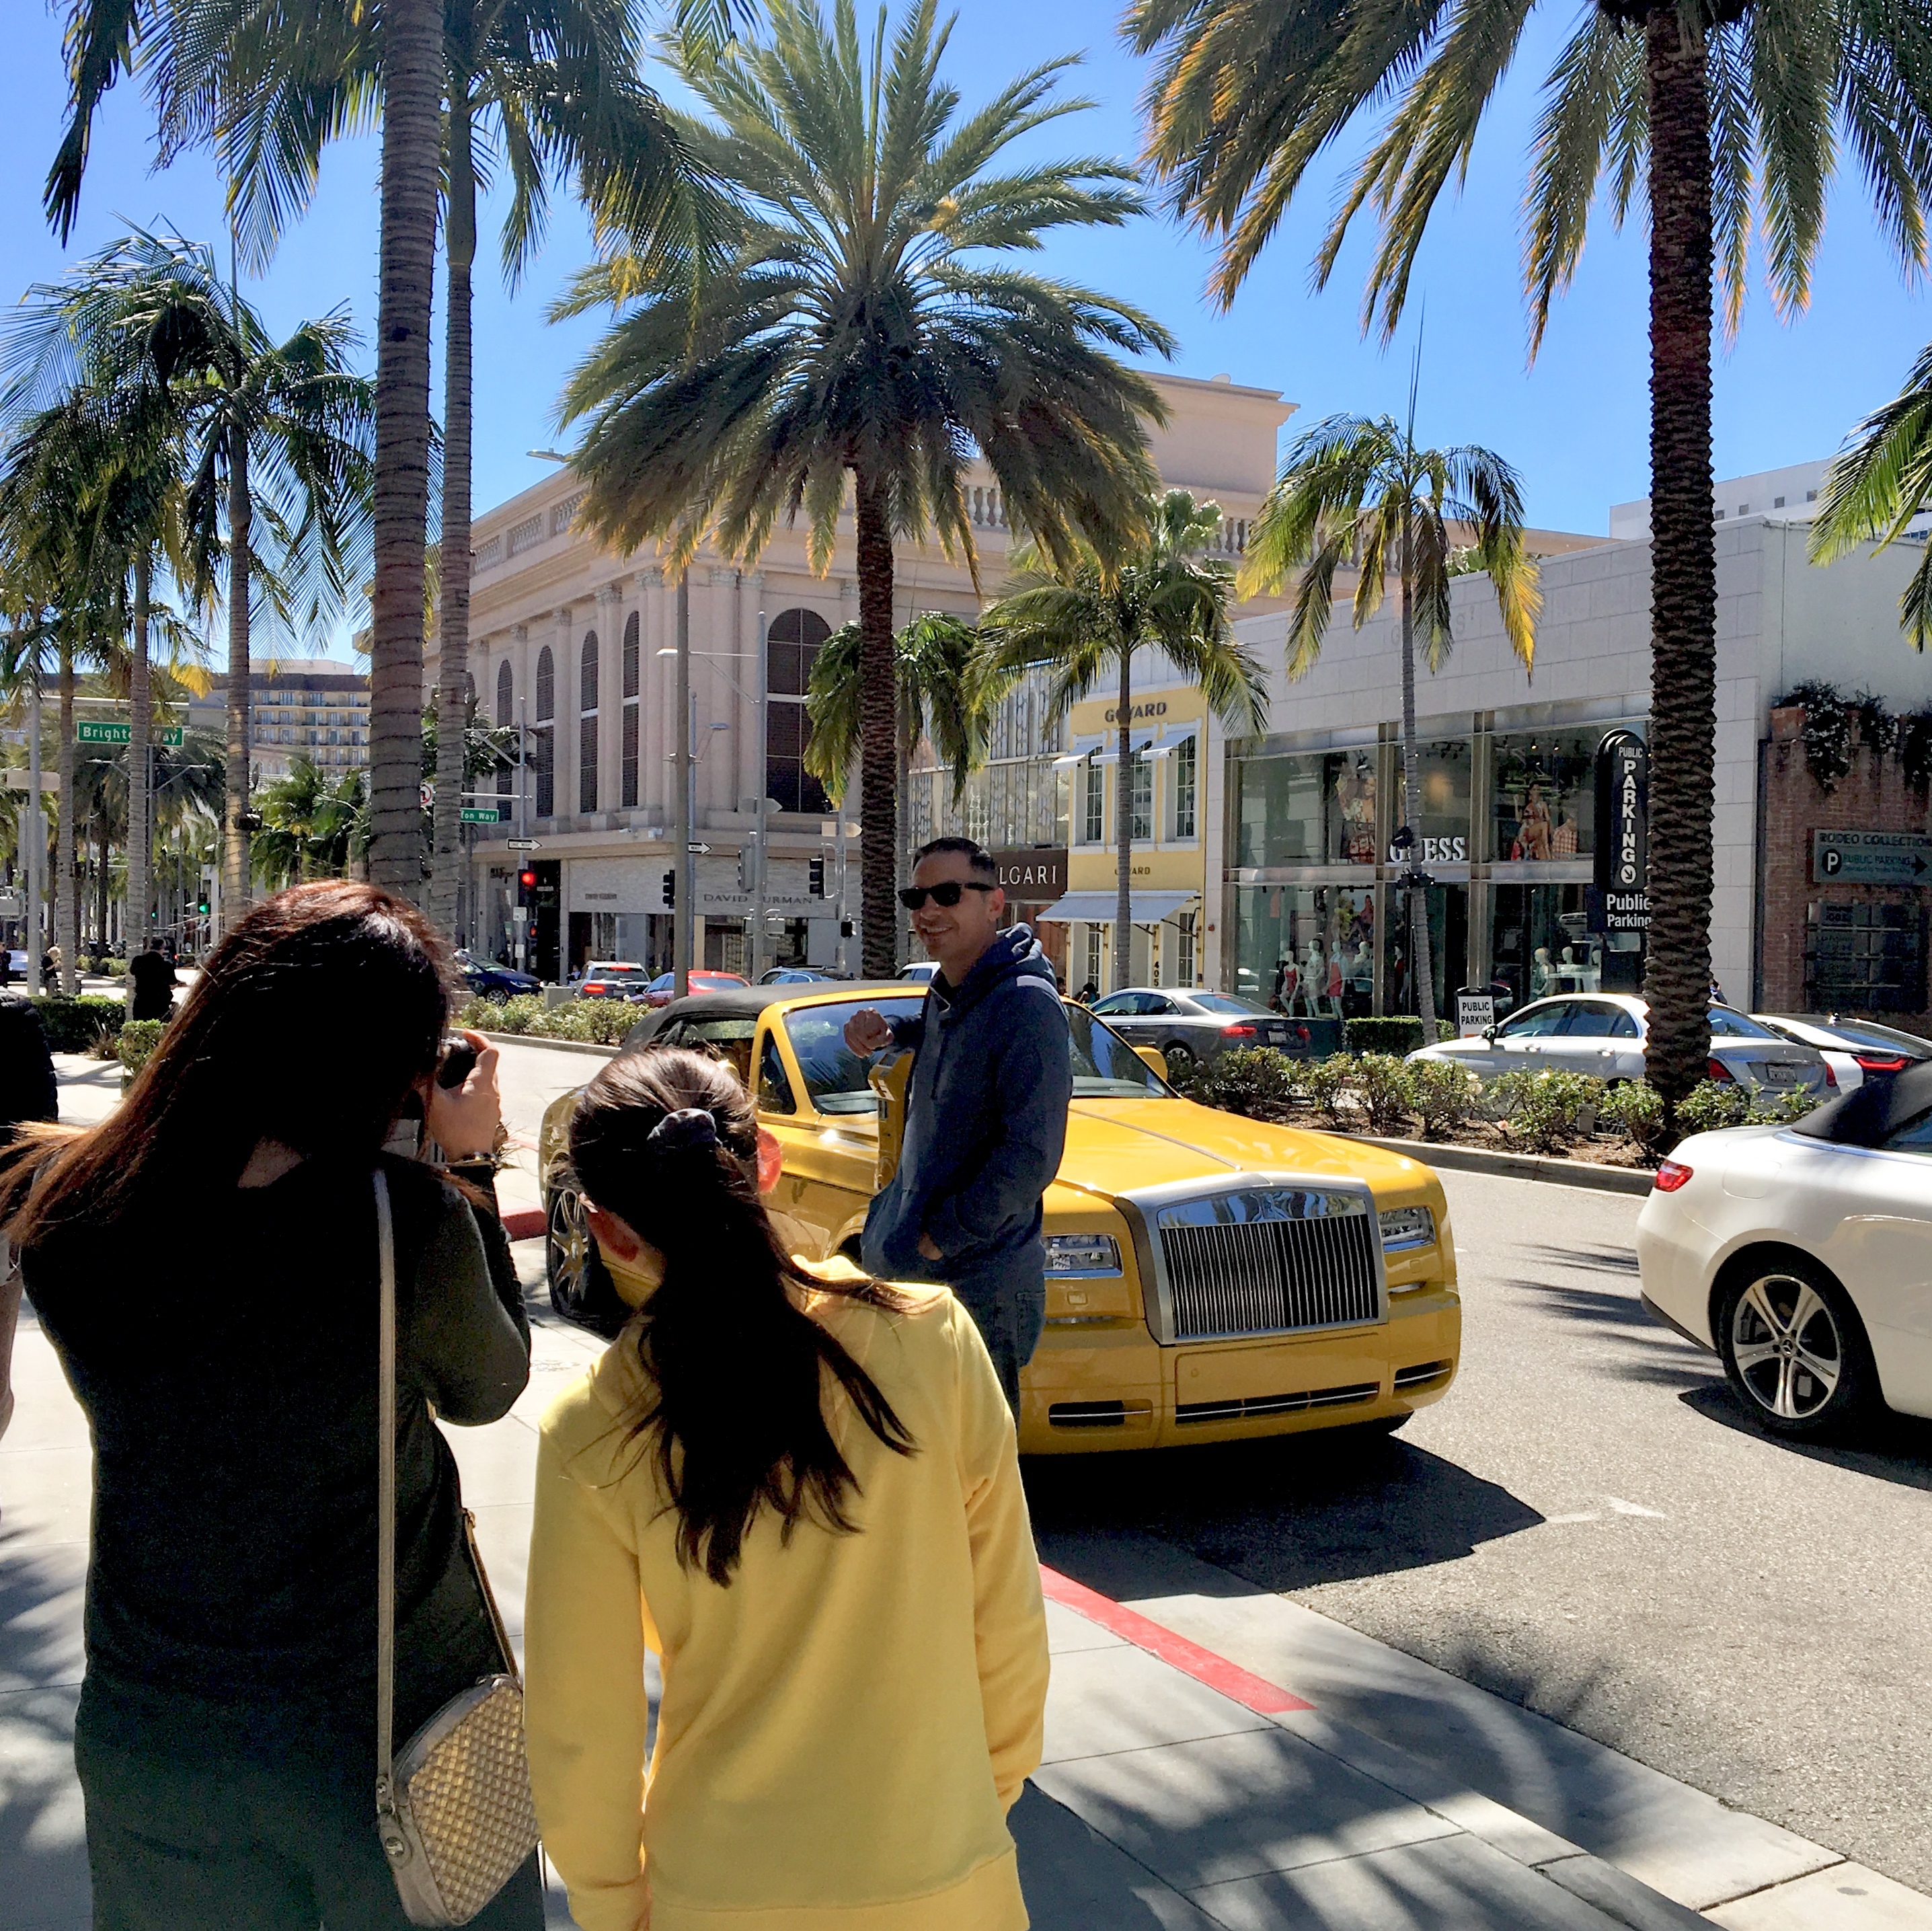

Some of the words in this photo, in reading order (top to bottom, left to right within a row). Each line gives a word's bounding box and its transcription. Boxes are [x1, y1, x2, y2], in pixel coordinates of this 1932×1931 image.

[1104, 702, 1167, 723] GYARD
[83, 726, 132, 742] Bright
[1619, 746, 1643, 759] PUBLIC
[460, 810, 475, 819] ton
[478, 812, 496, 821] Way
[1621, 759, 1637, 863] PARKING
[1819, 832, 1860, 844] RODEO
[1389, 836, 1467, 862] GESS
[999, 865, 1057, 885] LGARI
[703, 893, 748, 903] DAVID
[762, 895, 812, 905] URMAN
[1606, 893, 1651, 911] Public
[1607, 913, 1652, 930] Parking
[1462, 1001, 1490, 1012] PUBLIC
[1461, 1015, 1492, 1026] PARKING
